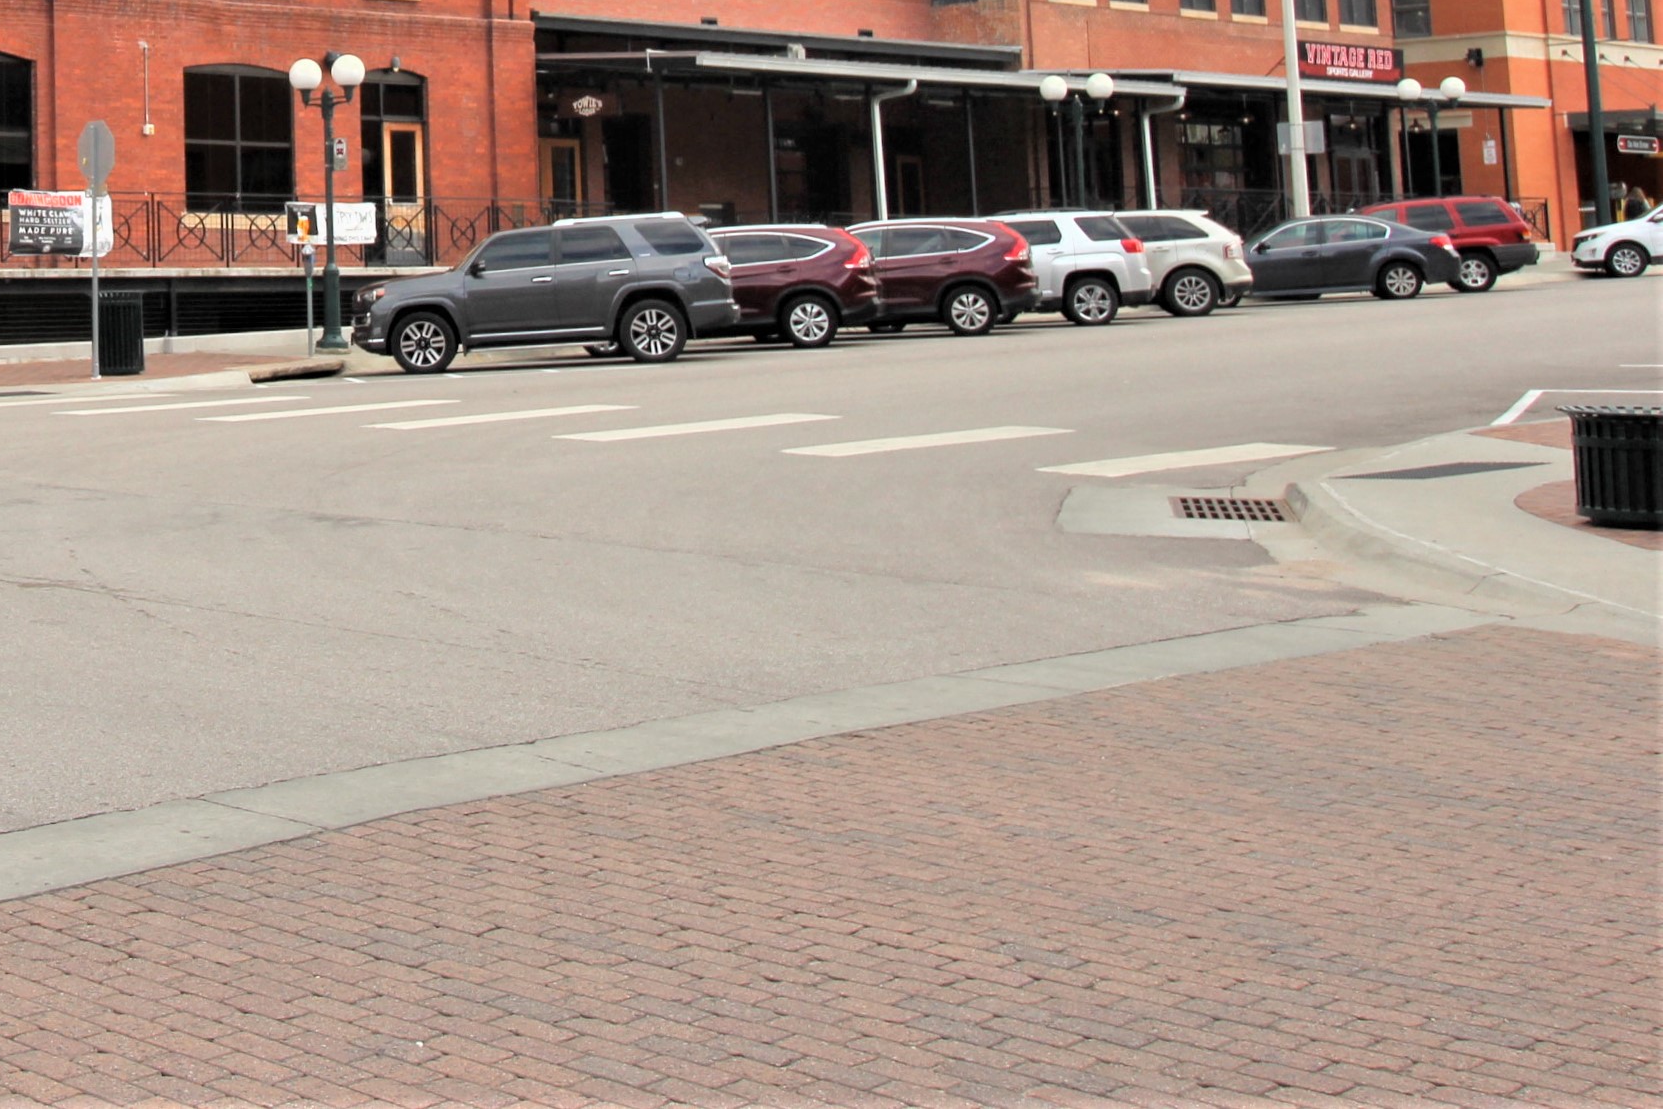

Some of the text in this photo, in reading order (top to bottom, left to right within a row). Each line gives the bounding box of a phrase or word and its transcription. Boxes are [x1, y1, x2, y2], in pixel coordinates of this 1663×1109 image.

[1305, 42, 1393, 70] VINTAGE RED
[1326, 66, 1374, 78] SPORTS GALLERY
[10, 192, 82, 207] COMING SOON
[18, 209, 71, 218] WHITE CLAW
[42, 217, 72, 225] SELTZER
[18, 227, 73, 235] MADE PURE
